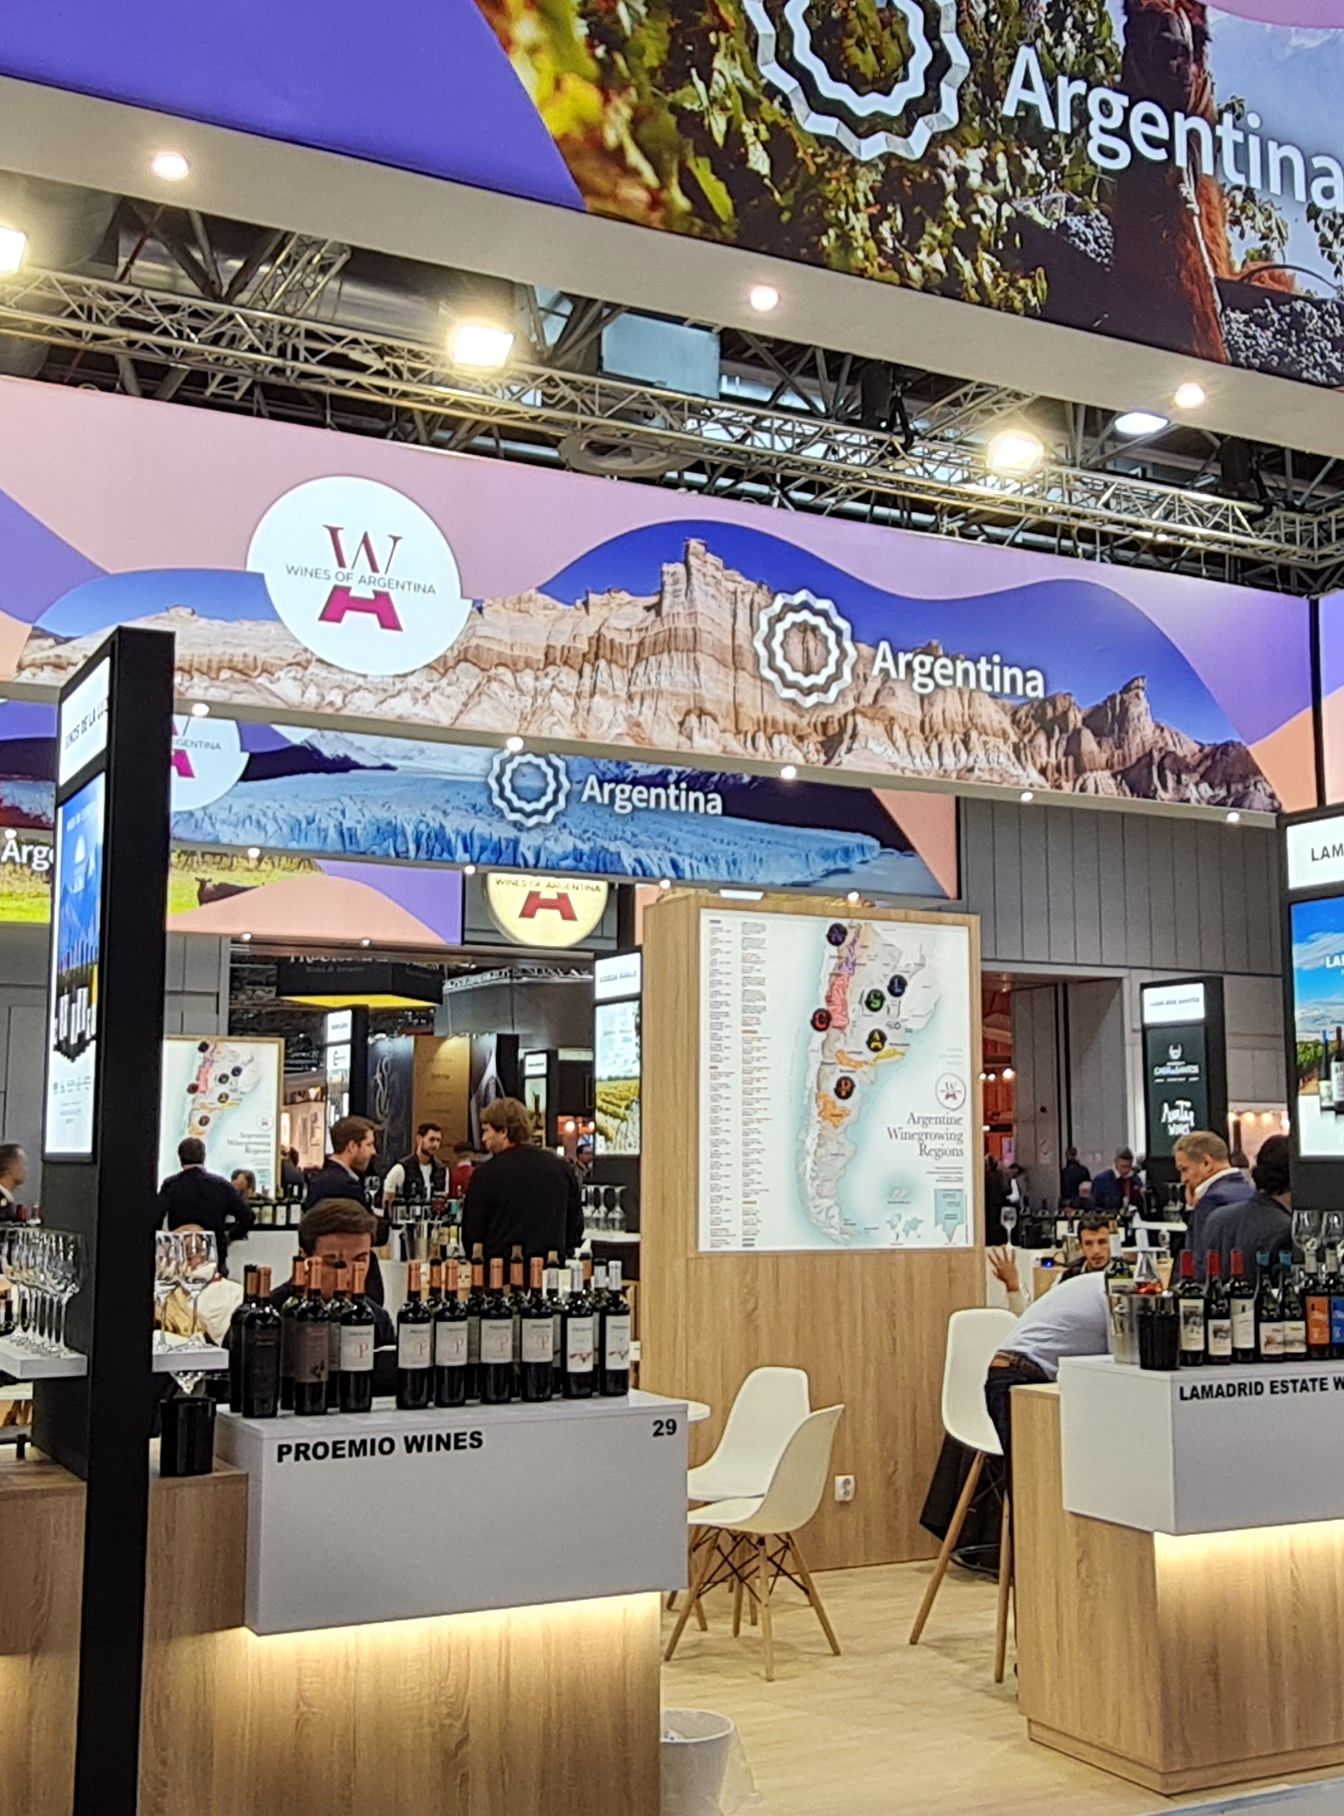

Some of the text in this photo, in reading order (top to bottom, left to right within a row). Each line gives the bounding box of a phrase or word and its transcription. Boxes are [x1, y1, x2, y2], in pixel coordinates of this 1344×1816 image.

[285, 564, 436, 595] WINES OF ARGENTINA
[871, 640, 1046, 699] Argentina
[581, 774, 723, 815] Argentina
[906, 1111, 963, 1128] Argentine
[887, 1126, 964, 1144] Winegrowing
[919, 1142, 964, 1160] Regions
[1179, 1380, 1265, 1402] LAMADRID
[1269, 1377, 1329, 1396] ESTATE
[652, 1418, 678, 1438] 29
[276, 1430, 484, 1464] PROEMIO WINES
